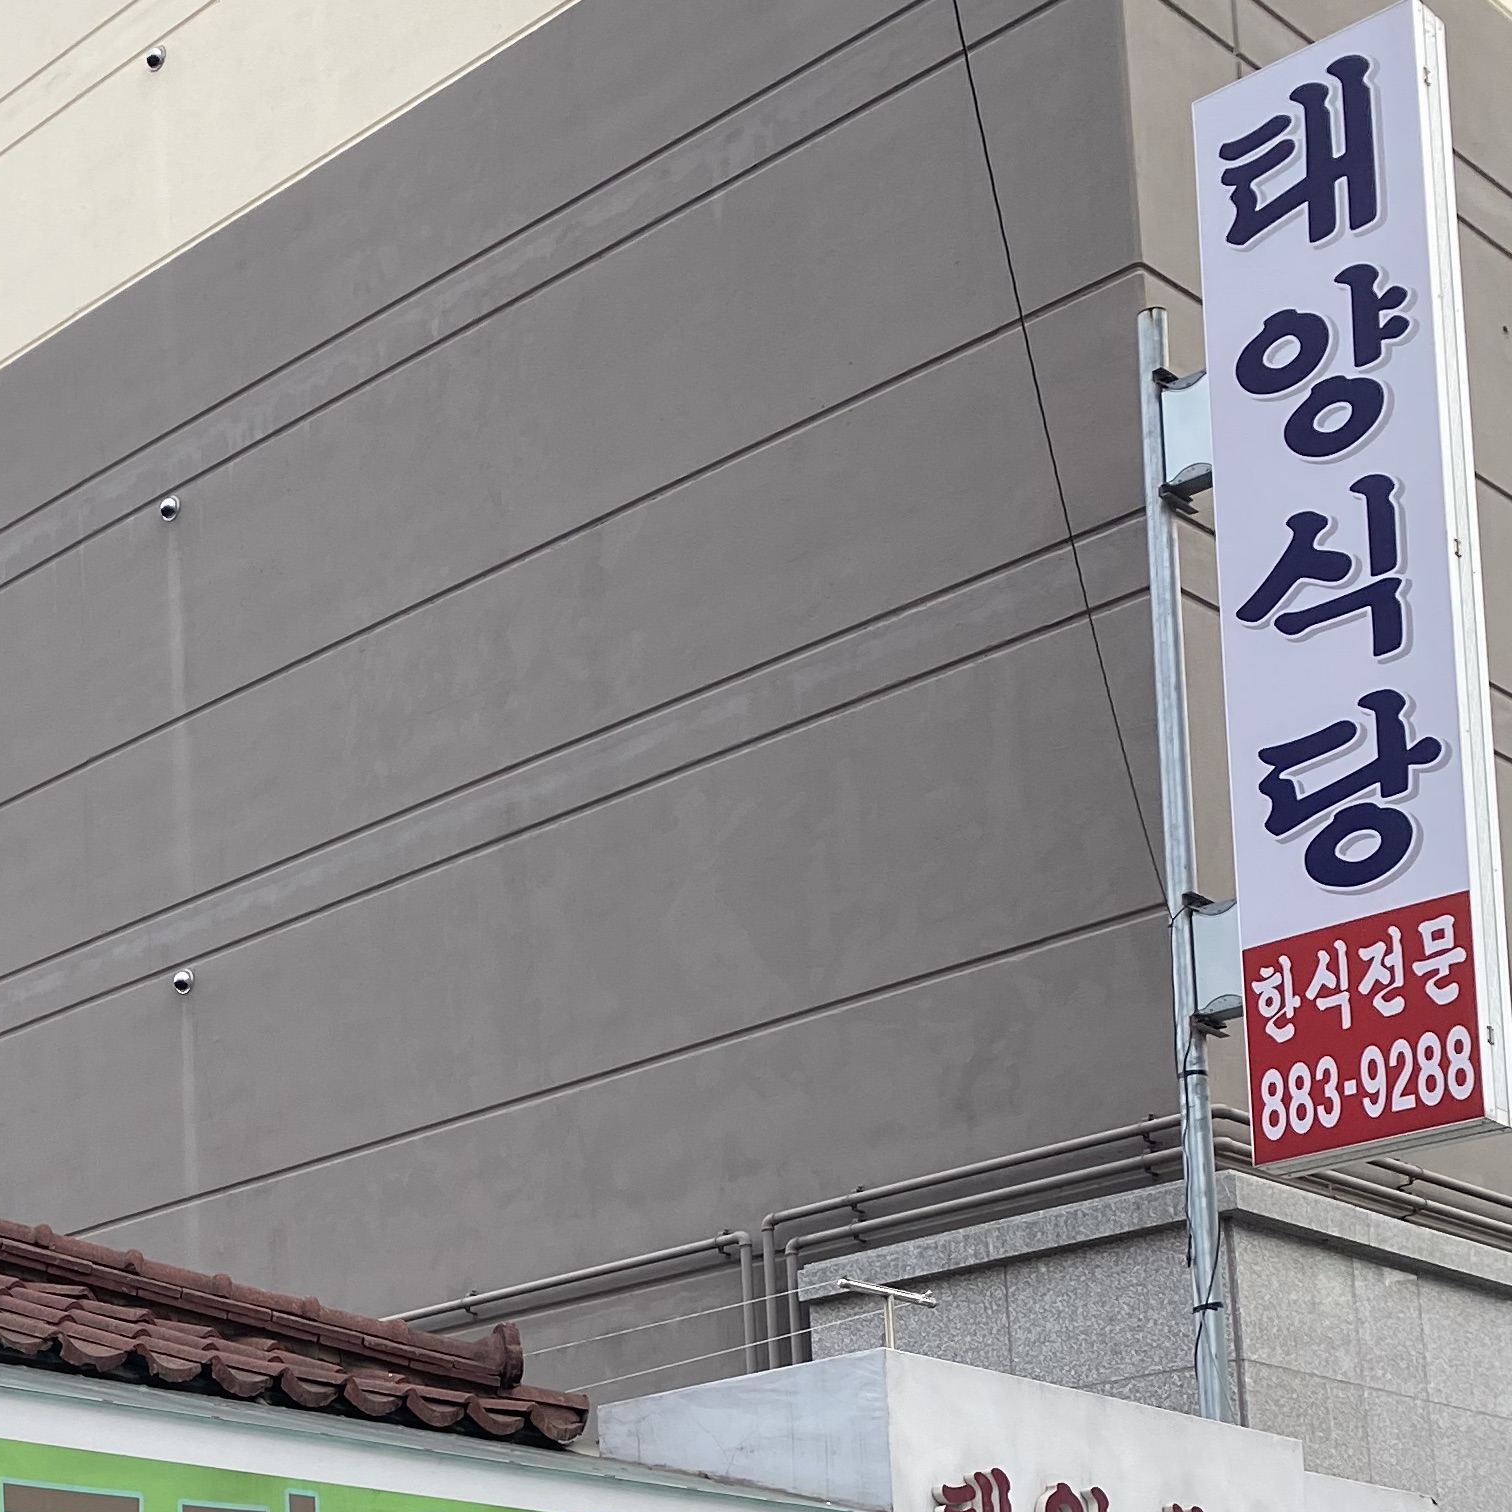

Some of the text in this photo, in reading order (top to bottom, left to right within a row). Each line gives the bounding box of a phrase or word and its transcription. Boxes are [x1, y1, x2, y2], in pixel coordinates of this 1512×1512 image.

[1218, 53, 1444, 889] 태양식당
[1250, 912, 1469, 1044] 한식전문
[1259, 1023, 1477, 1142] 883-9288
